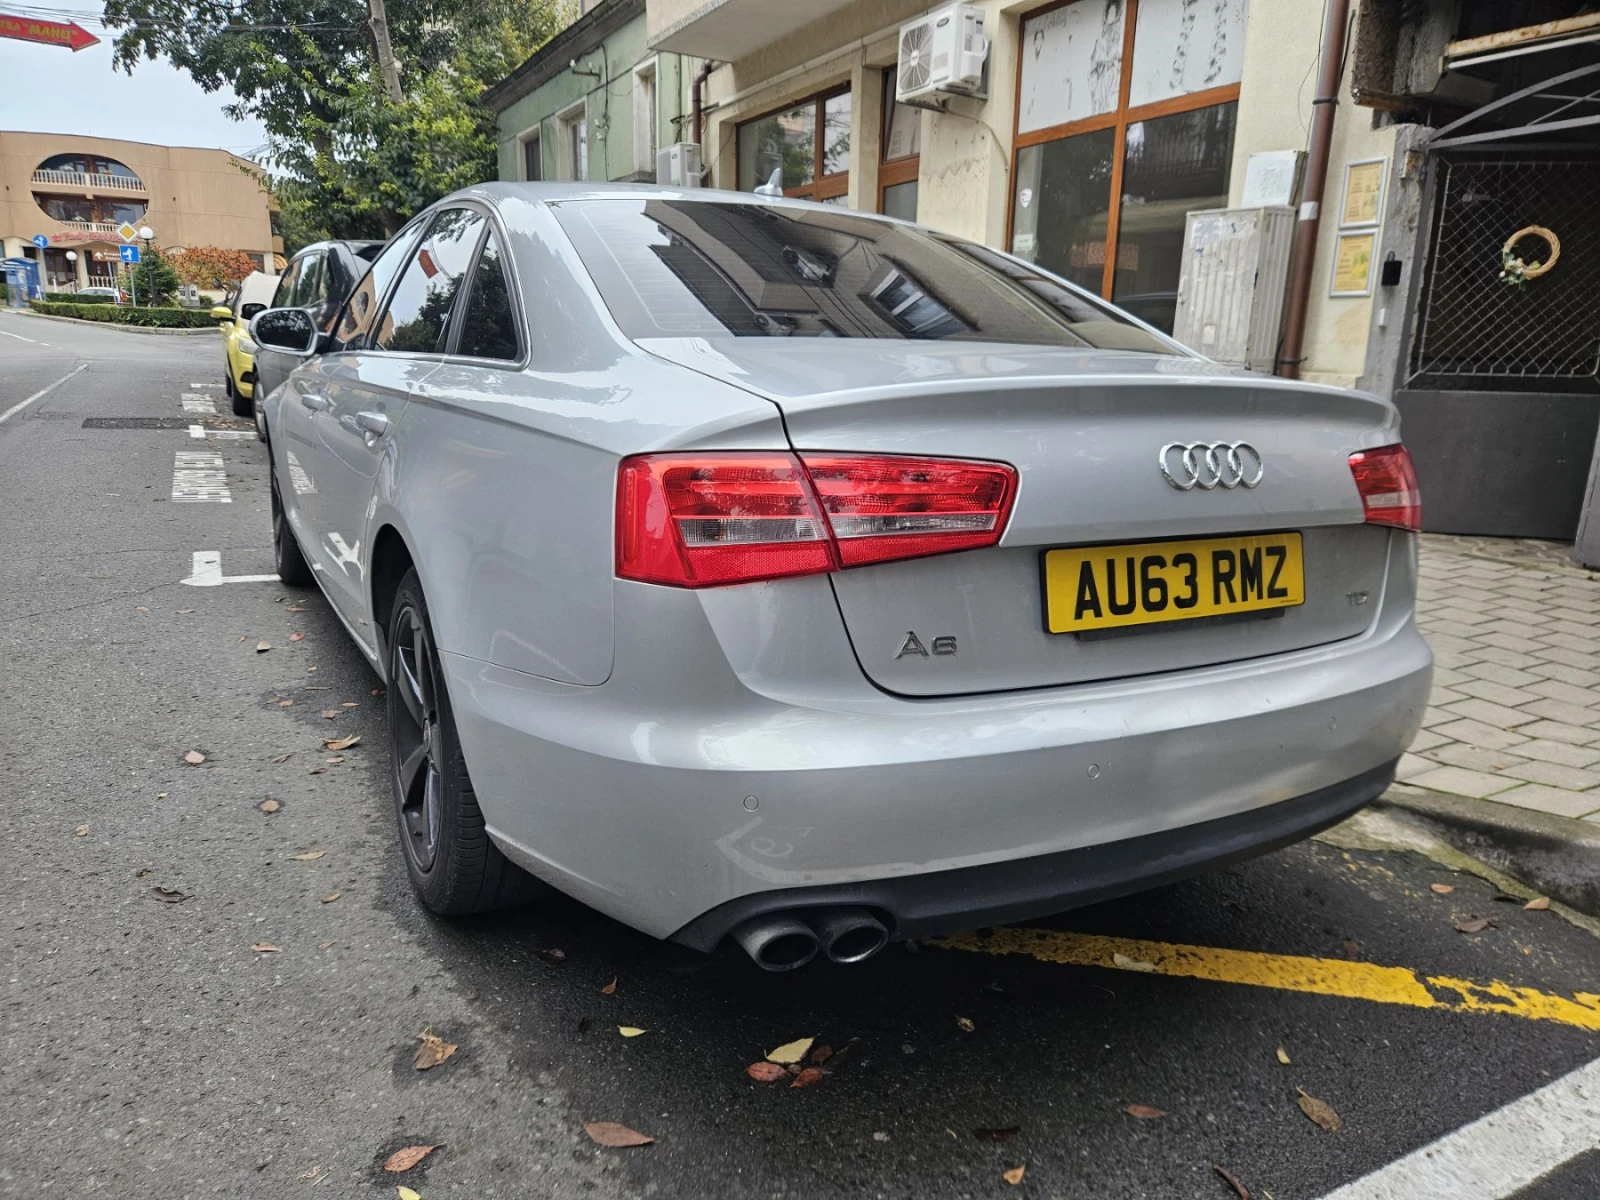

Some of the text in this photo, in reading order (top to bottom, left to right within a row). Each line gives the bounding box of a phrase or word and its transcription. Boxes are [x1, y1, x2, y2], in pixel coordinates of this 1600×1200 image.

[1074, 545, 1288, 620] AU63 RMZ
[893, 630, 957, 660] A6
